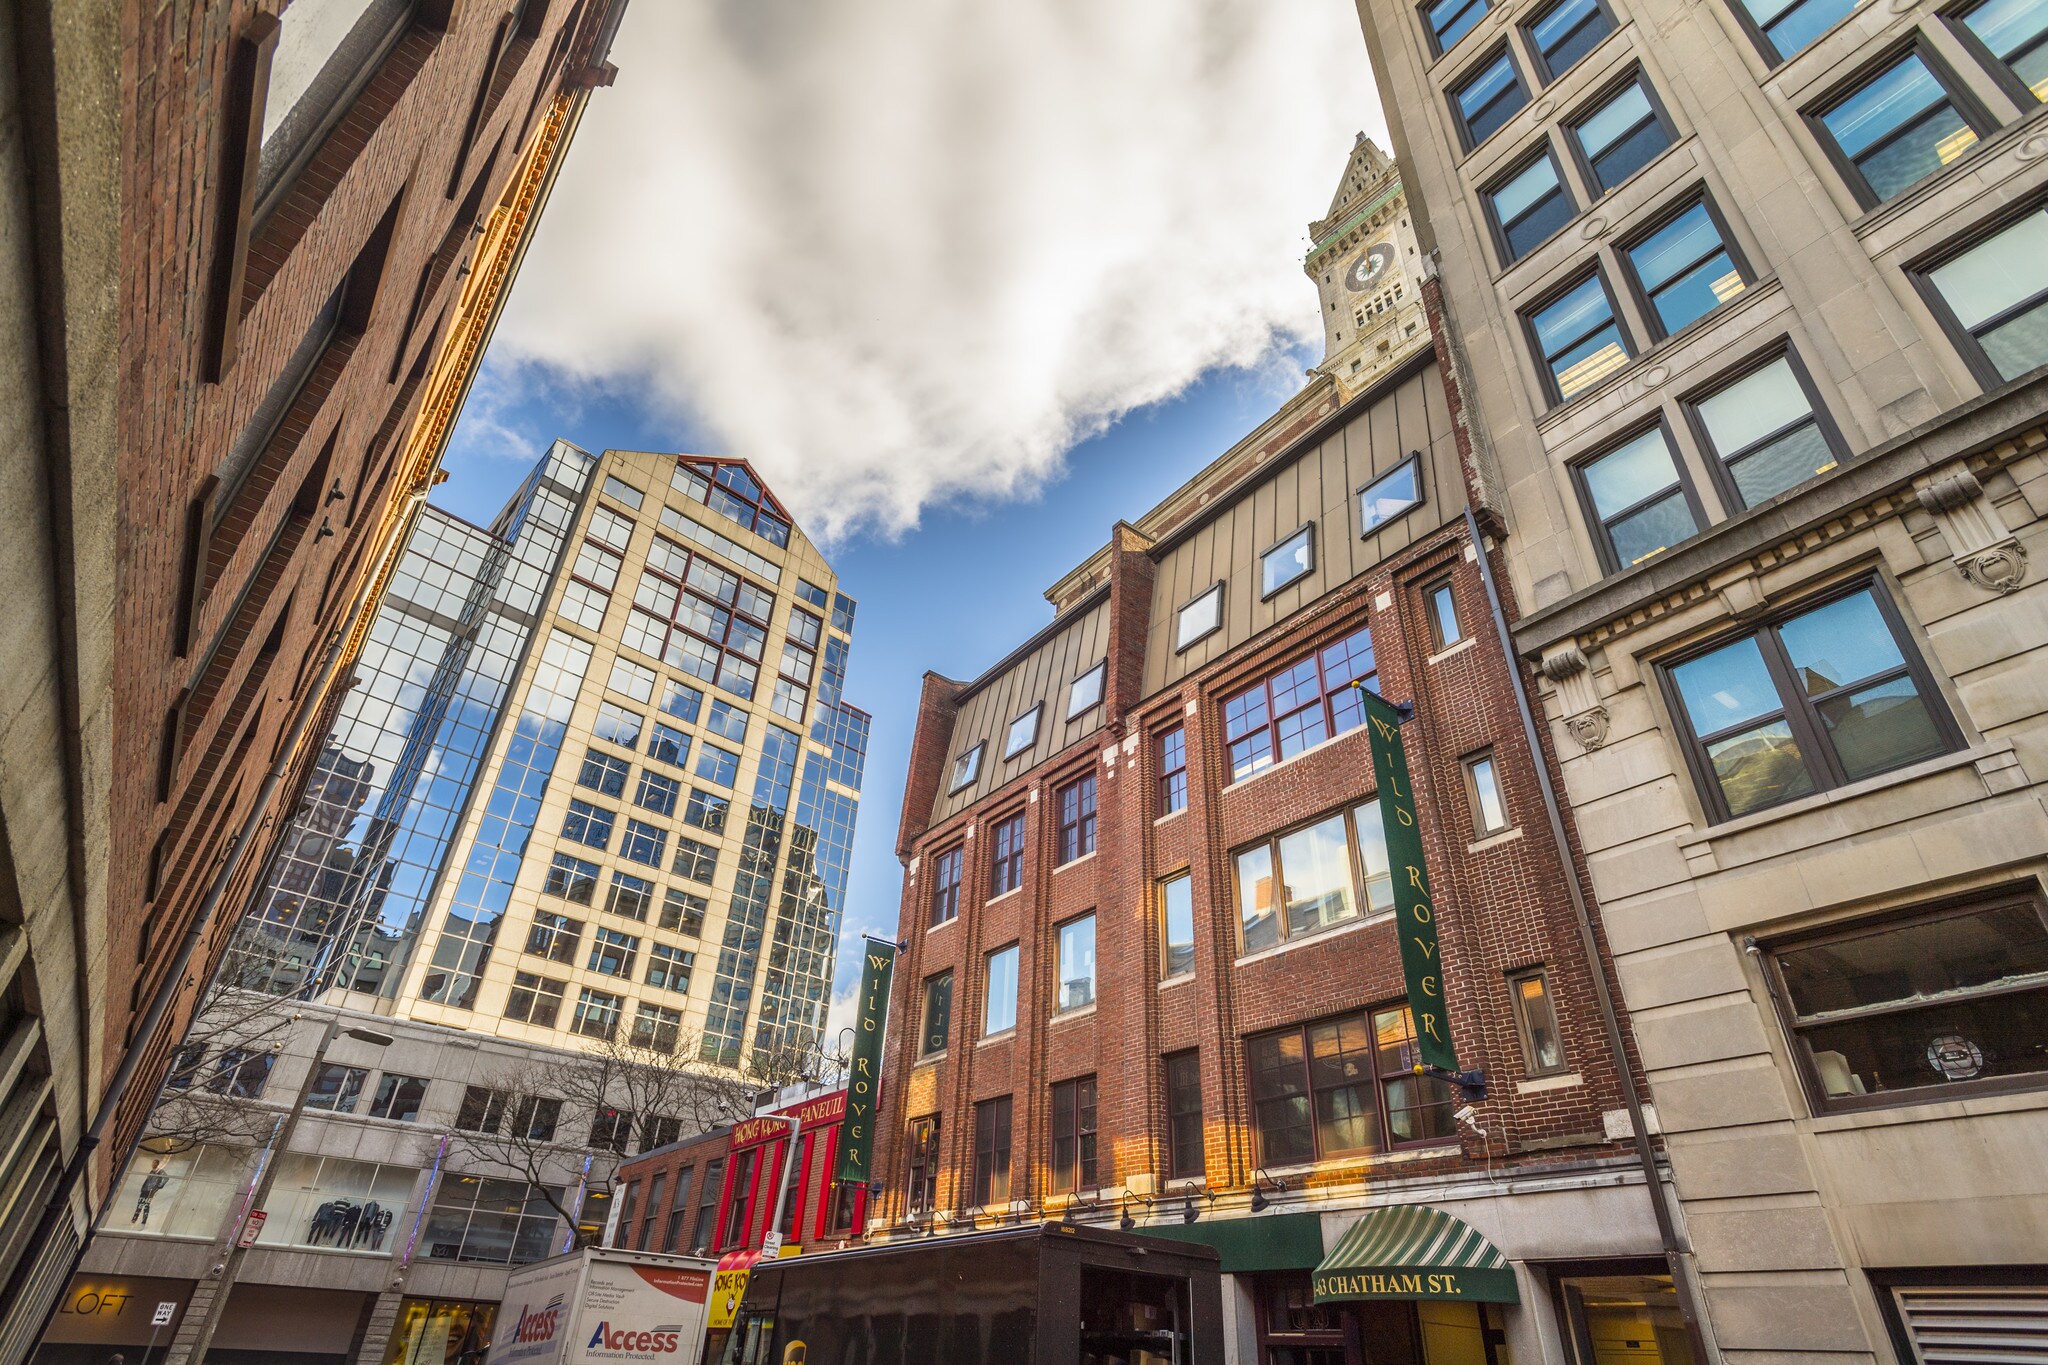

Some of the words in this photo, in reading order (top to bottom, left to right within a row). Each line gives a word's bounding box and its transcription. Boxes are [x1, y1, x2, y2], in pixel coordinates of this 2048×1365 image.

[1405, 865, 1442, 1043] ROVER
[734, 1119, 760, 1145] HONG
[800, 1096, 843, 1124] FANEUIL
[848, 1057, 871, 1166] ROVER
[1328, 1274, 1424, 1295] CHATHAM
[1428, 1273, 1462, 1294] ST.
[60, 1292, 135, 1317] LOFT
[511, 1303, 559, 1344] Access
[587, 1320, 679, 1353] Access
[585, 1349, 624, 1359] Information
[625, 1350, 656, 1361] Protected.
